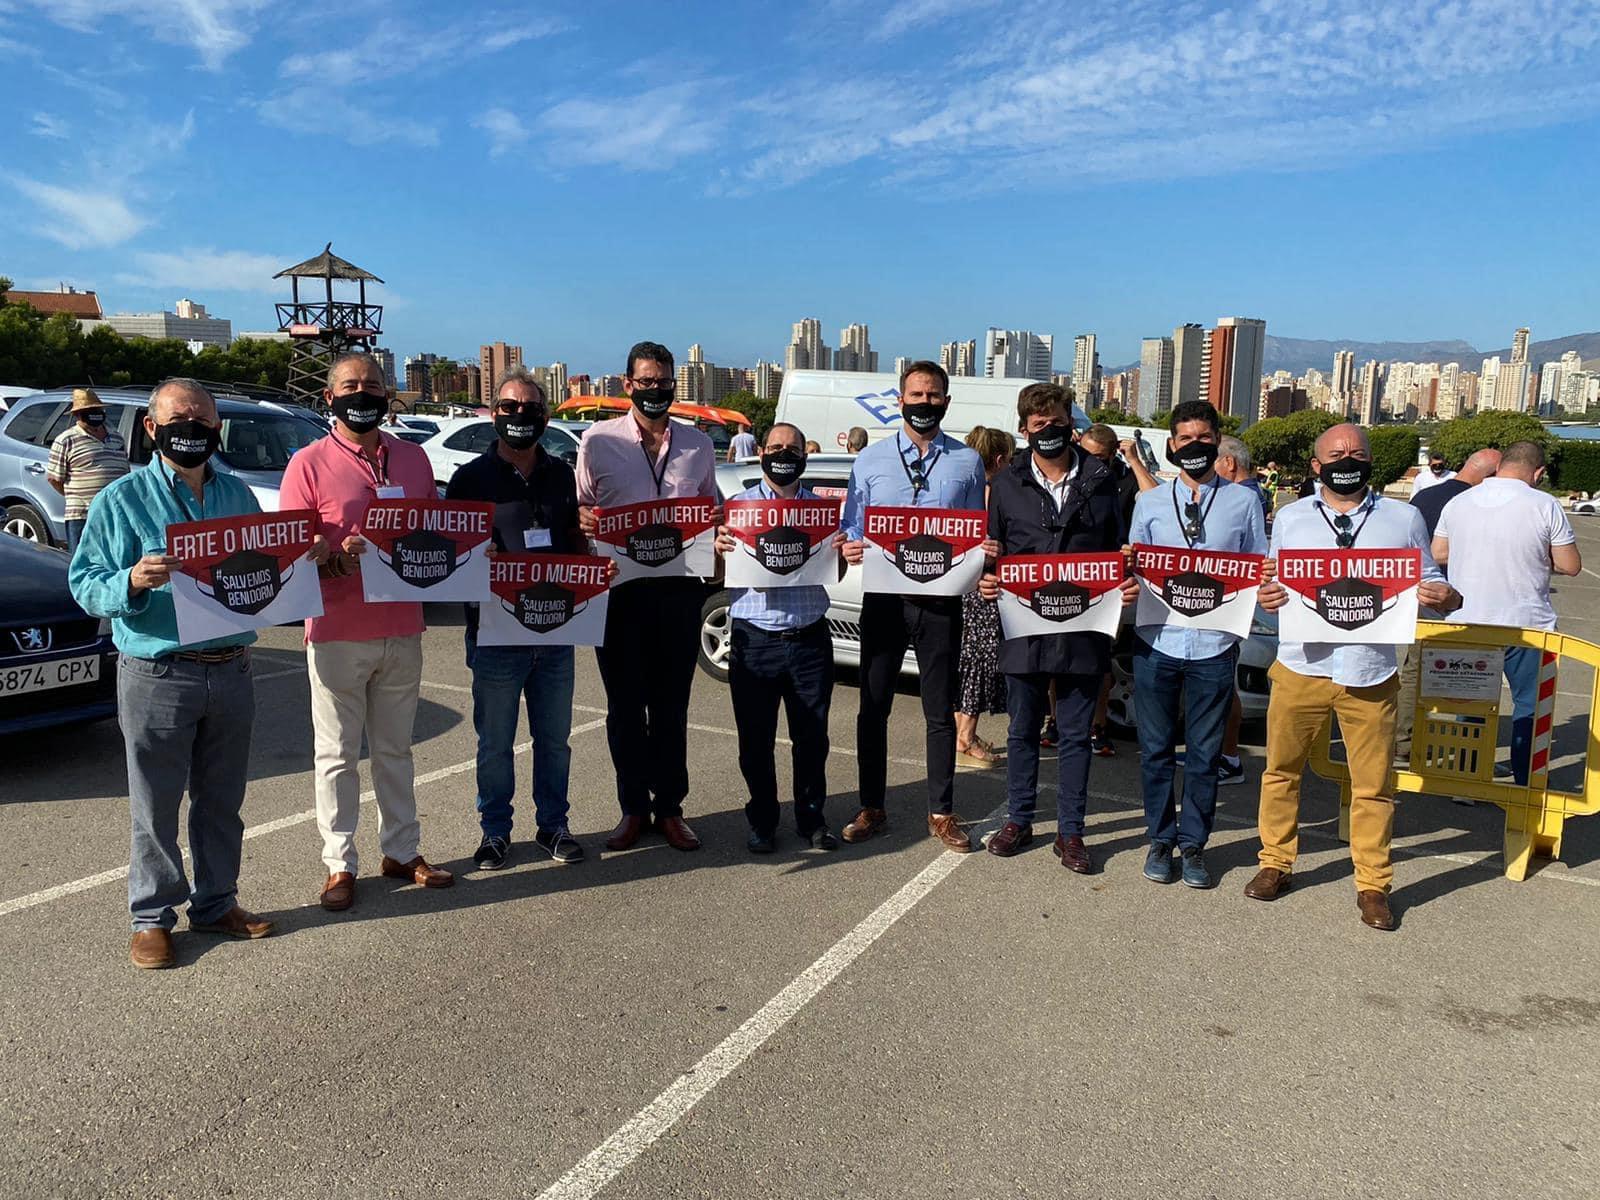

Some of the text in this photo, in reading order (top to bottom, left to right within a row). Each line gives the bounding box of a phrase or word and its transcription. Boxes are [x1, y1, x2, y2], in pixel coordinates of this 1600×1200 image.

[365, 508, 488, 533] ERTE O MUERTE
[599, 505, 710, 535] ERTE O MUERTE
[728, 508, 836, 527] ERTE O MUERTE
[868, 515, 983, 538] ERTE O MUERTE
[173, 520, 309, 561] ERTE O MUERTE
[636, 548, 676, 561] BENIDORM
[766, 554, 803, 568] BENIDORM
[402, 564, 448, 578] BENIDORM
[490, 561, 606, 585] ERTE O MUERTE
[904, 562, 944, 576] BENIDORM
[1001, 561, 1119, 583] ERTE O MUERTE
[1136, 551, 1259, 580] ERTE O MUERTE
[1283, 558, 1416, 579] ERTE O MUERTE
[227, 584, 275, 606] BENIDORM
[1171, 595, 1215, 610] BENIDORM
[524, 612, 565, 625] BENIDORM
[1041, 604, 1082, 616] BENIDORM
[1328, 608, 1374, 622] BENIDORM
[57, 659, 94, 682] CPX
